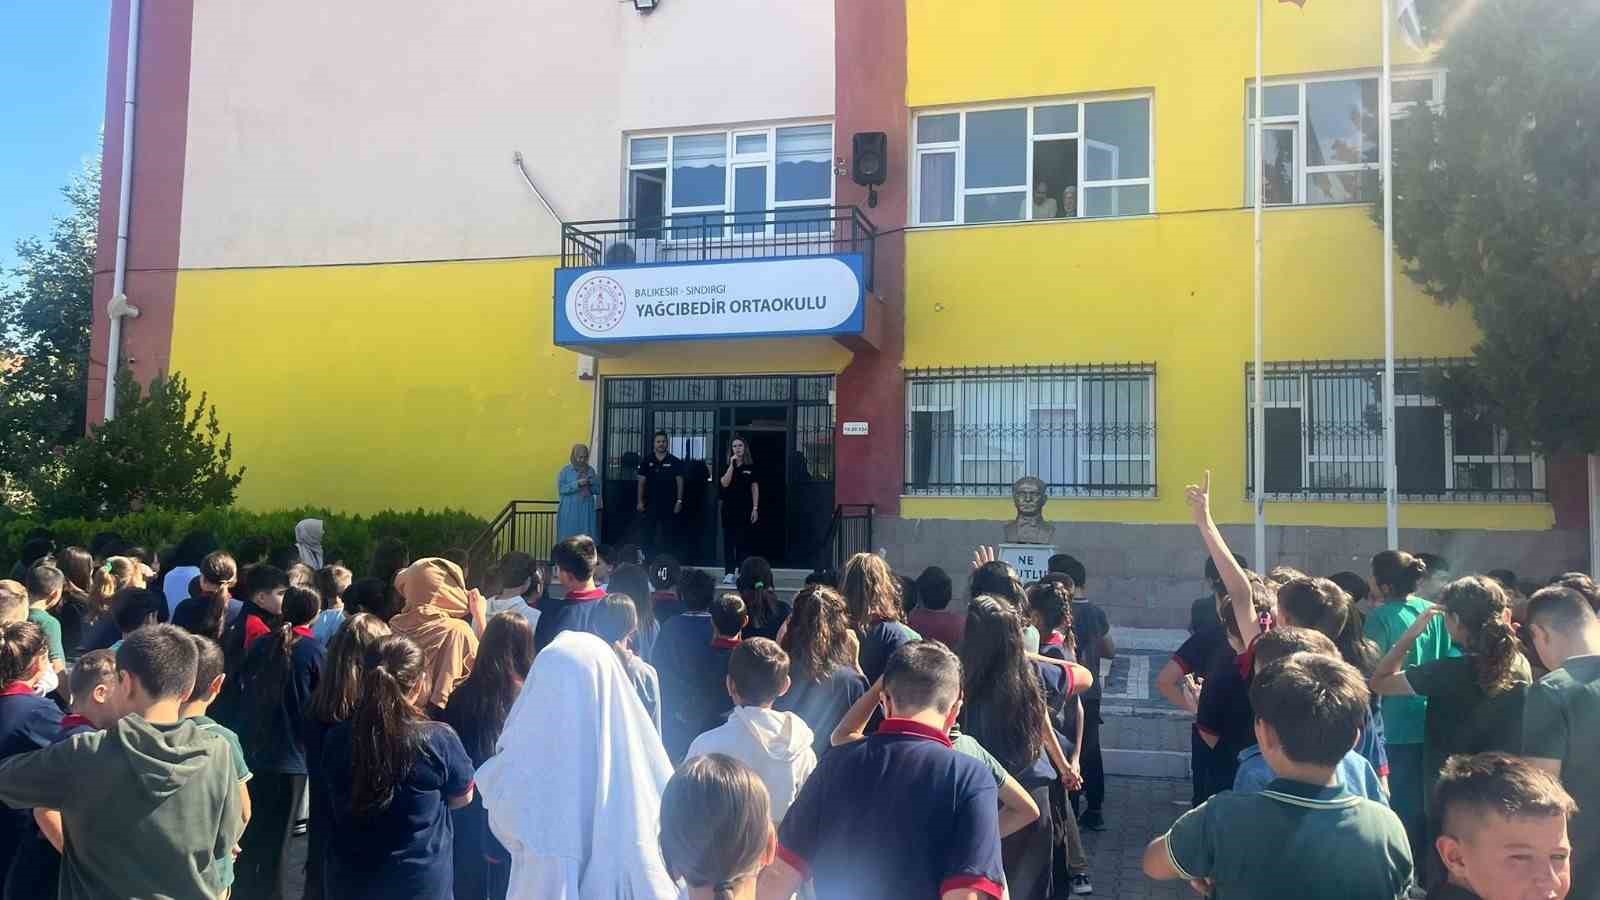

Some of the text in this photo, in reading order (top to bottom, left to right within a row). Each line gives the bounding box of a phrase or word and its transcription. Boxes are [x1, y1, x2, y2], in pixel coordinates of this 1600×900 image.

[635, 295, 826, 317] YAĞCIBEDİR ORTAOKULU
[1018, 555, 1033, 566] NE
